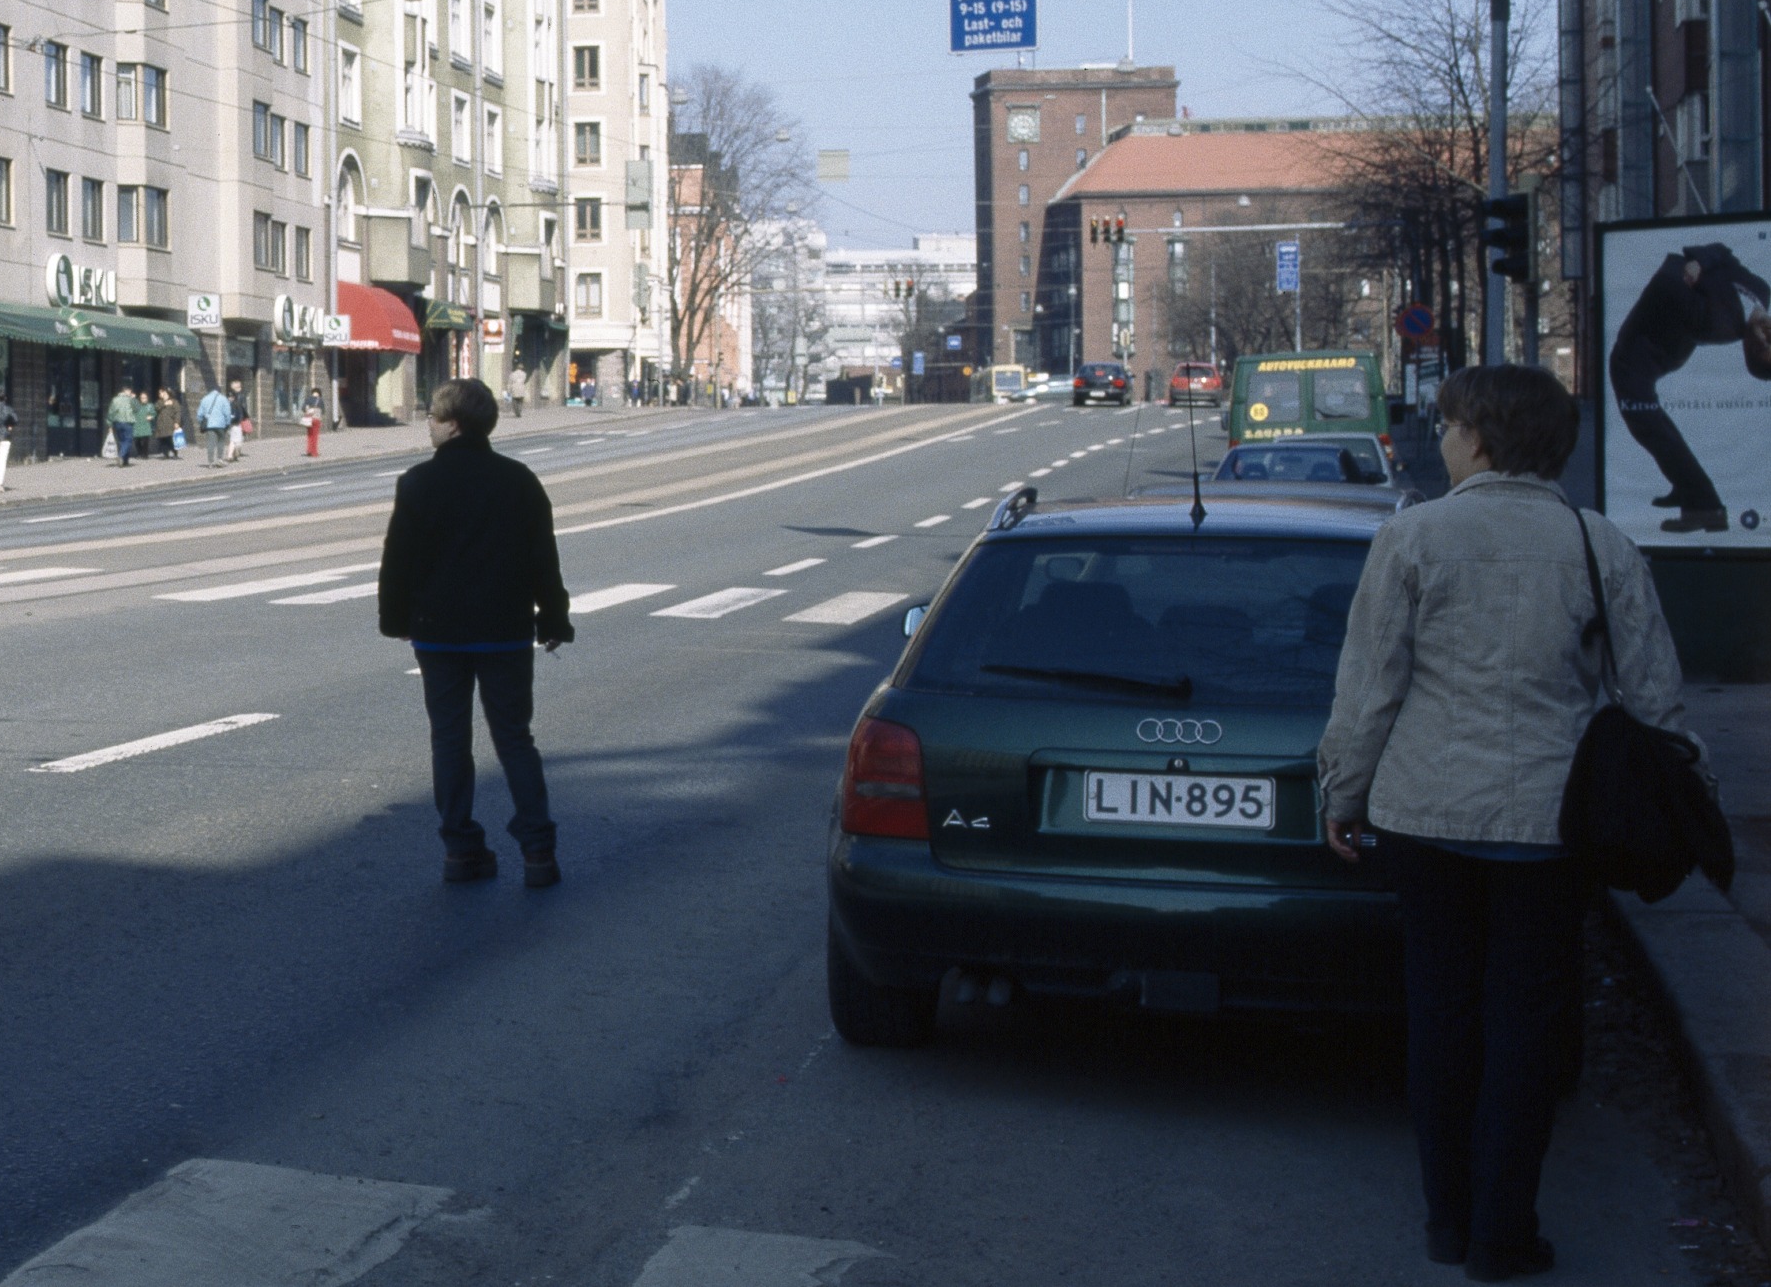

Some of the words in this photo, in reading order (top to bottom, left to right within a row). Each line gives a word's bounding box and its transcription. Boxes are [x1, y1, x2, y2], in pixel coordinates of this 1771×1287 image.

[959, 1, 986, 16] 9-15
[964, 18, 996, 32] Last-
[1001, 15, 1023, 29] och
[964, 29, 1023, 48] paketbilar
[72, 264, 118, 306] ISKU
[190, 314, 219, 325] ISKU
[1620, 399, 1659, 411] Katso
[1095, 777, 1265, 820] LIN-895
